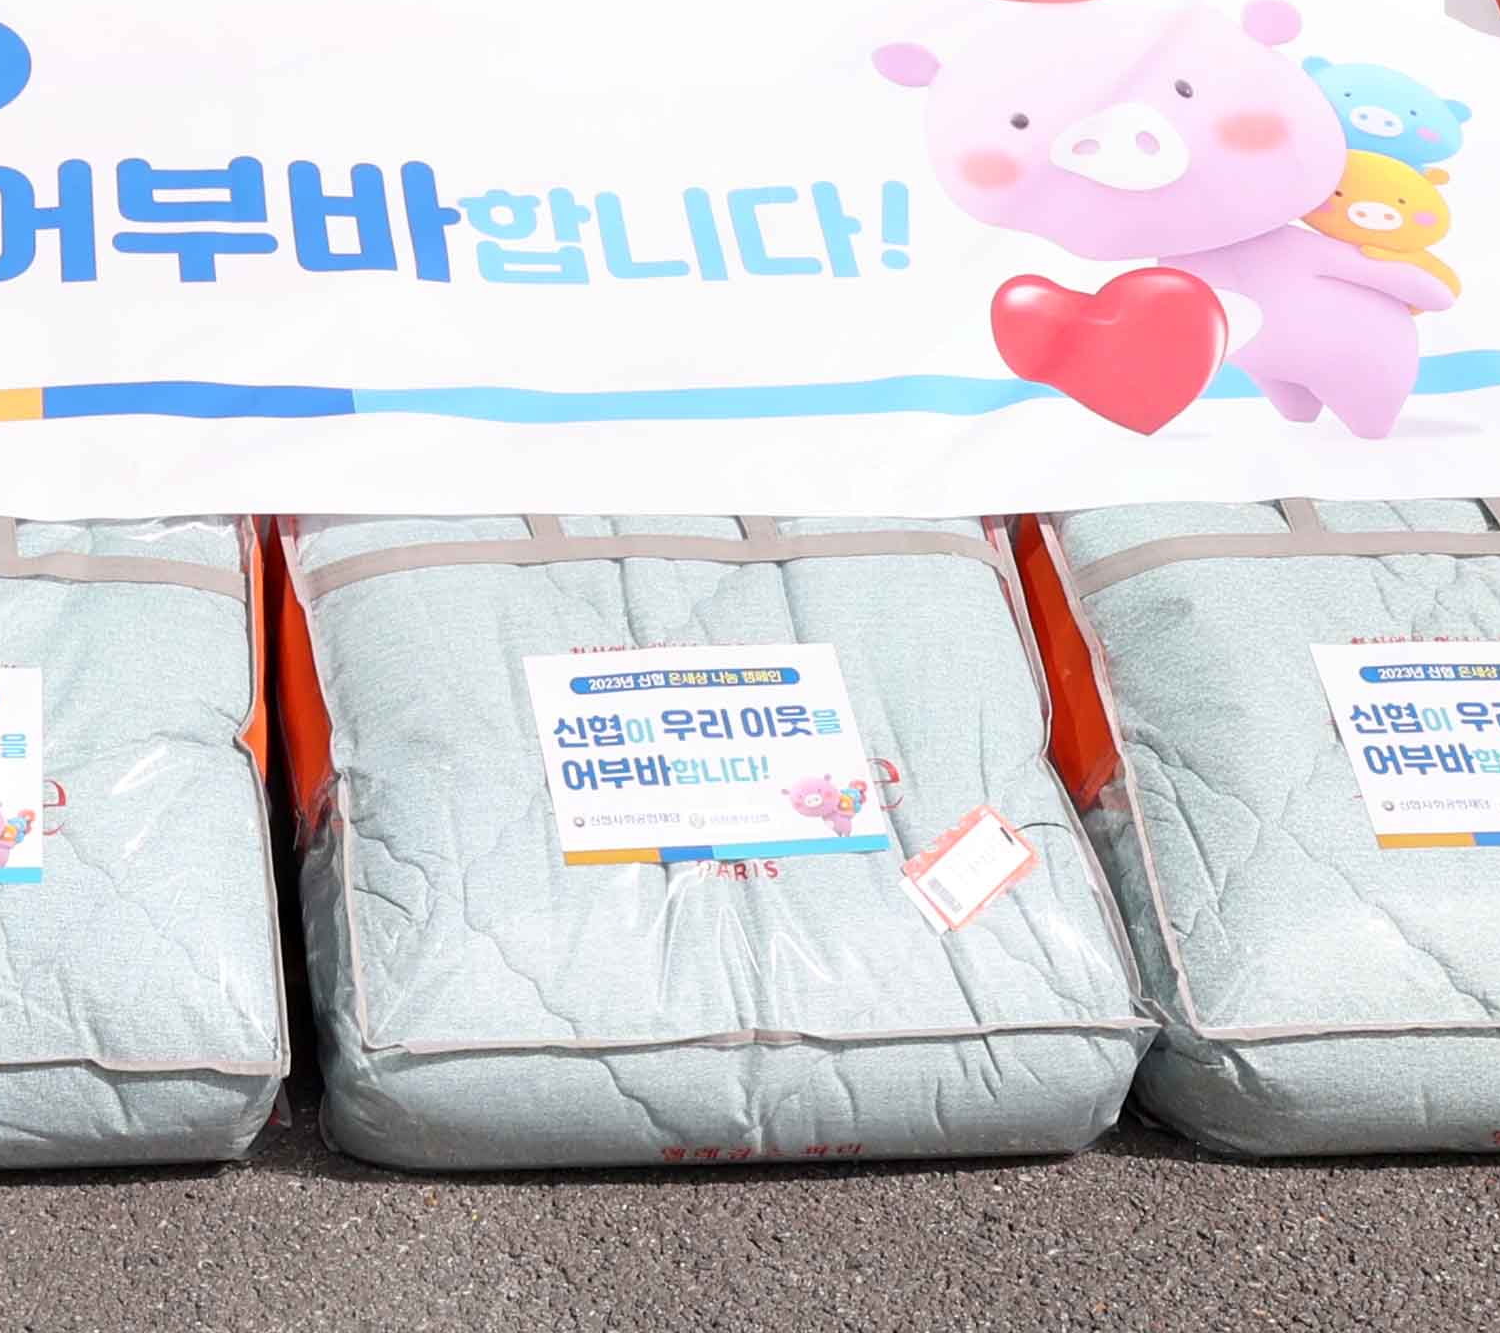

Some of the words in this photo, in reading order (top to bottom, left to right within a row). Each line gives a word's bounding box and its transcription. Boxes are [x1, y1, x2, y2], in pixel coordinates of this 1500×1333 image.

[553, 714, 654, 748] 신협이
[661, 709, 733, 741] 우리
[740, 705, 841, 737] 이웃을
[1350, 703, 1452, 734] 신협이
[562, 755, 768, 790] 어부바합니다!
